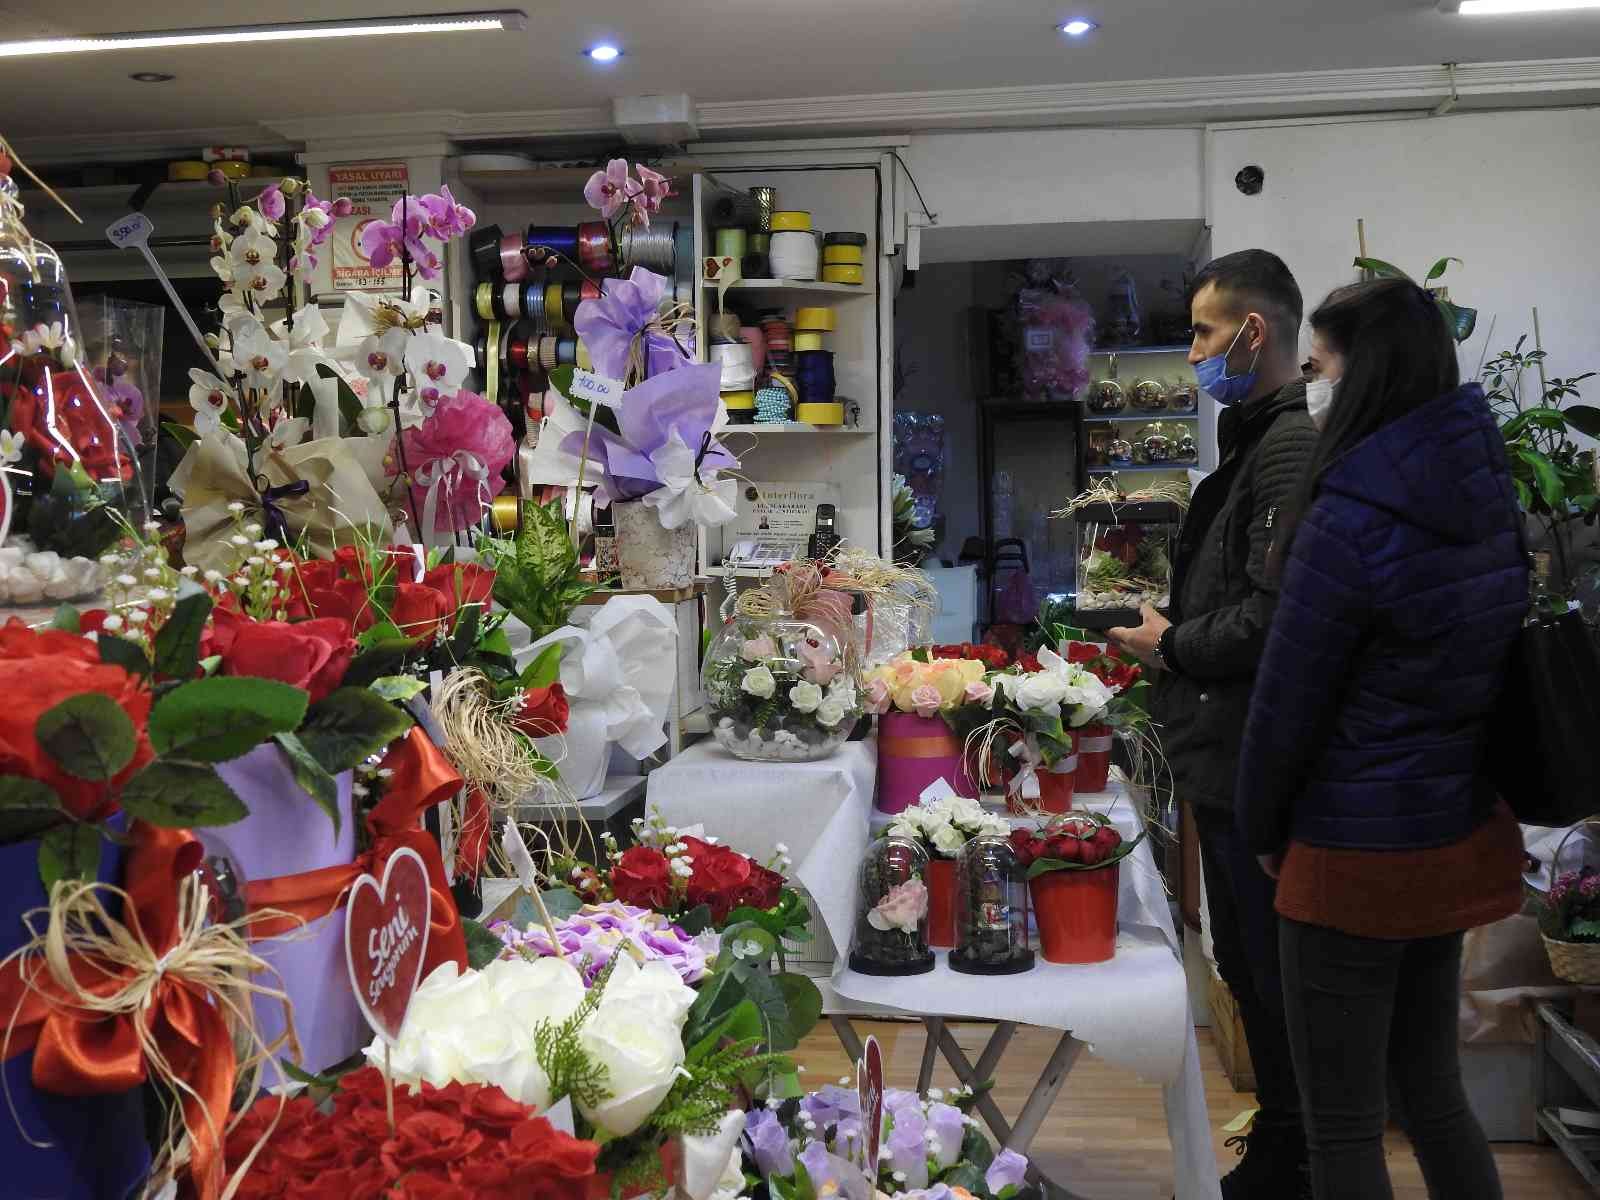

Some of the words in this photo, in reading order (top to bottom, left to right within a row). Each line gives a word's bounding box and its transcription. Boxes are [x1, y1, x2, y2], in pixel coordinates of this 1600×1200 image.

[336, 170, 367, 183] YASAL
[370, 167, 403, 181] UYARI
[368, 892, 410, 977] Seni
